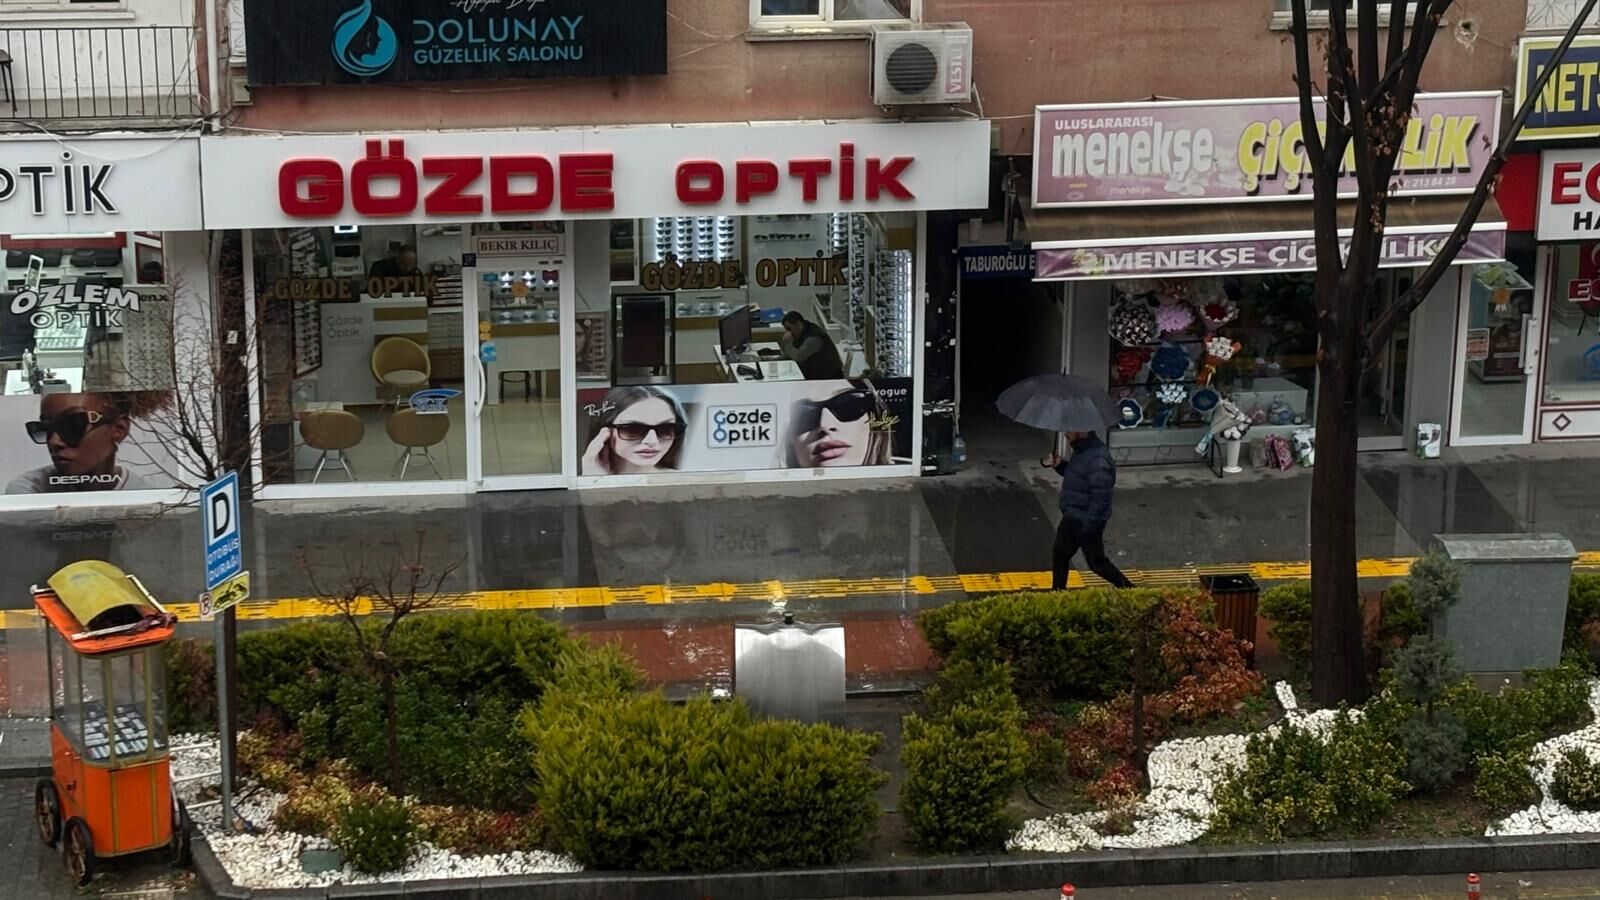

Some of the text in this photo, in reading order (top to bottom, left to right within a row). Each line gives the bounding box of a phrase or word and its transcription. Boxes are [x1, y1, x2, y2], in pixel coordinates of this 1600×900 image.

[413, 16, 583, 44] DOLUNAY
[413, 45, 583, 64] GÜZELLİK SALONU
[1534, 62, 1600, 113] NET
[1055, 116, 1154, 130] ULUSLARARASI
[278, 138, 915, 218] GÖZDE OPTİK
[641, 249, 850, 291] GÖZDE OPTİK
[964, 252, 1027, 273] TABUROĞLU
[1104, 245, 1256, 273] MENEKŞE
[10, 282, 140, 315] ÖZLEM
[30, 305, 123, 329] OPTİK
[714, 408, 772, 425] Gözde
[49, 474, 123, 486] DESPADA
[212, 492, 231, 538] D
[208, 537, 240, 565] OTOBÜS
